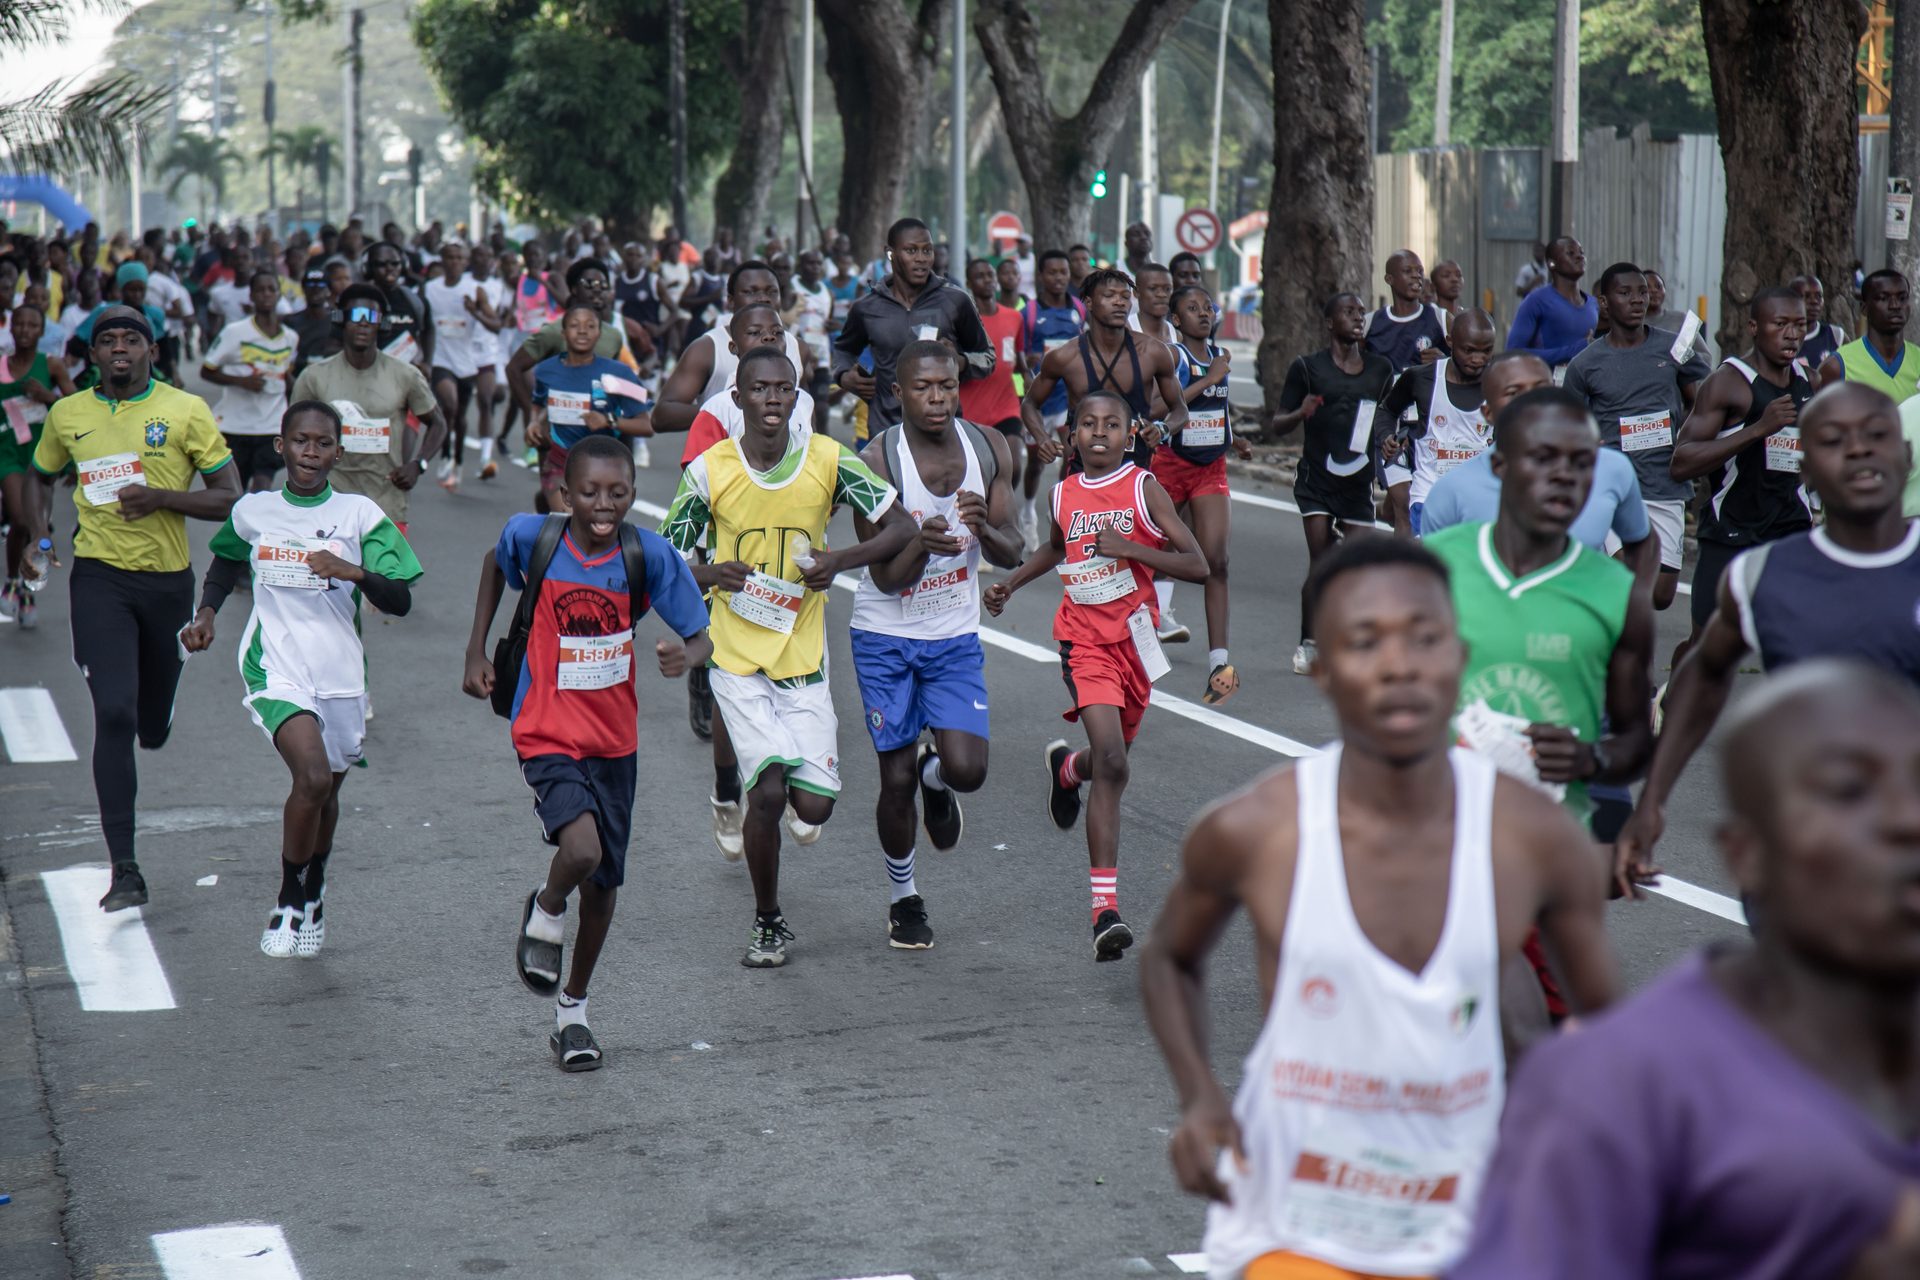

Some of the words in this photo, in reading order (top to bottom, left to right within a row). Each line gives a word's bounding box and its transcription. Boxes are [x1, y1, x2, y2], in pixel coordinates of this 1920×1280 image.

[1628, 420, 1664, 433] 16205
[88, 463, 135, 483] 00949
[268, 548, 315, 562] 1597
[909, 572, 959, 593] 0324
[1069, 561, 1119, 586] 00937
[743, 581, 792, 607] 00277
[572, 645, 624, 662] 15872
